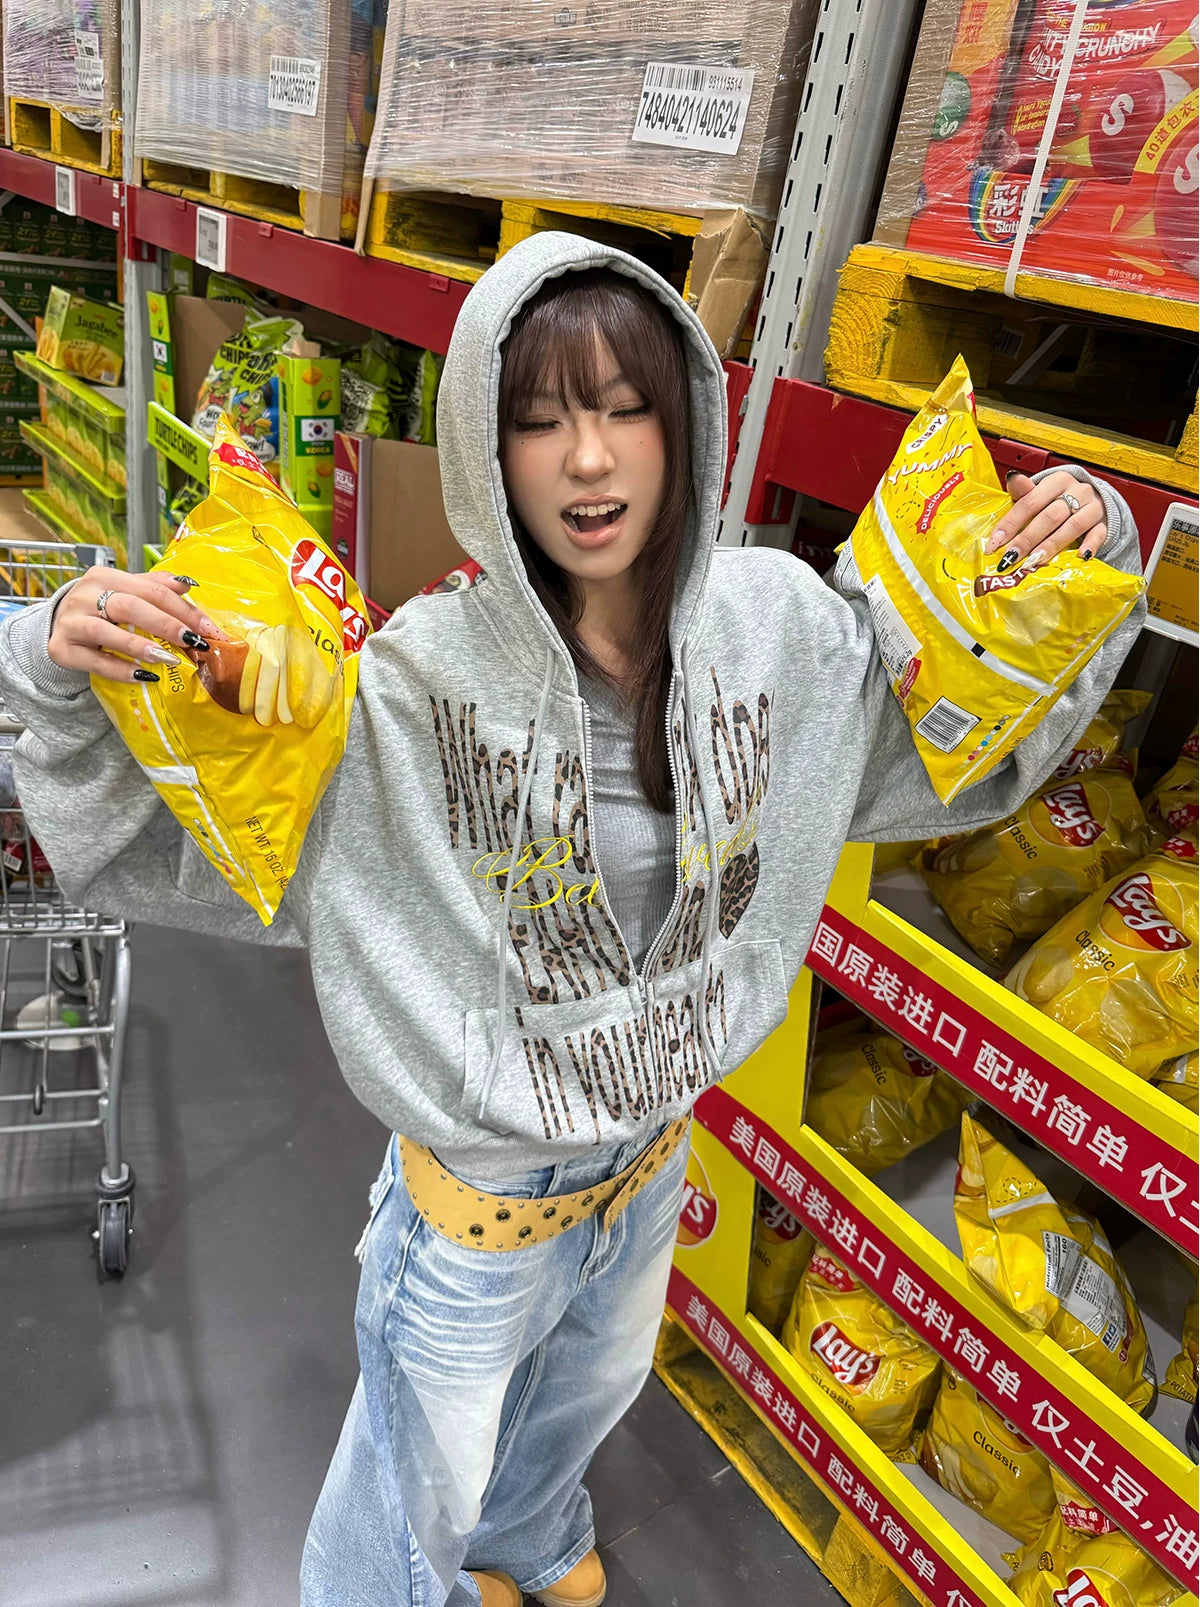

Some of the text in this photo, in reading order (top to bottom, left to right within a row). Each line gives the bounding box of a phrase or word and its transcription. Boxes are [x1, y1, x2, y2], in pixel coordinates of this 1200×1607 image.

[637, 91, 741, 140] 74840421140624
[910, 416, 943, 449] CRISPY
[887, 443, 973, 486] YUMMY
[920, 473, 963, 531] DELICIOUSLY
[244, 815, 260, 835] NET
[1042, 783, 1101, 841] Lay's
[1003, 815, 1038, 860] Classic
[1110, 875, 1187, 945] Lay's
[1075, 929, 1116, 972] Classic
[861, 1043, 887, 1085] Classic
[972, 1040, 1132, 1174] 配料简单
[729, 1116, 886, 1280] 美国原装进口
[891, 1267, 1023, 1404] 配料简单
[1061, 1237, 1069, 1254] 160
[811, 1323, 876, 1385] Lay's
[810, 1372, 856, 1413] Classic
[686, 1295, 938, 1587] 美国原装进口 配料简单
[972, 1430, 1021, 1475] Classic
